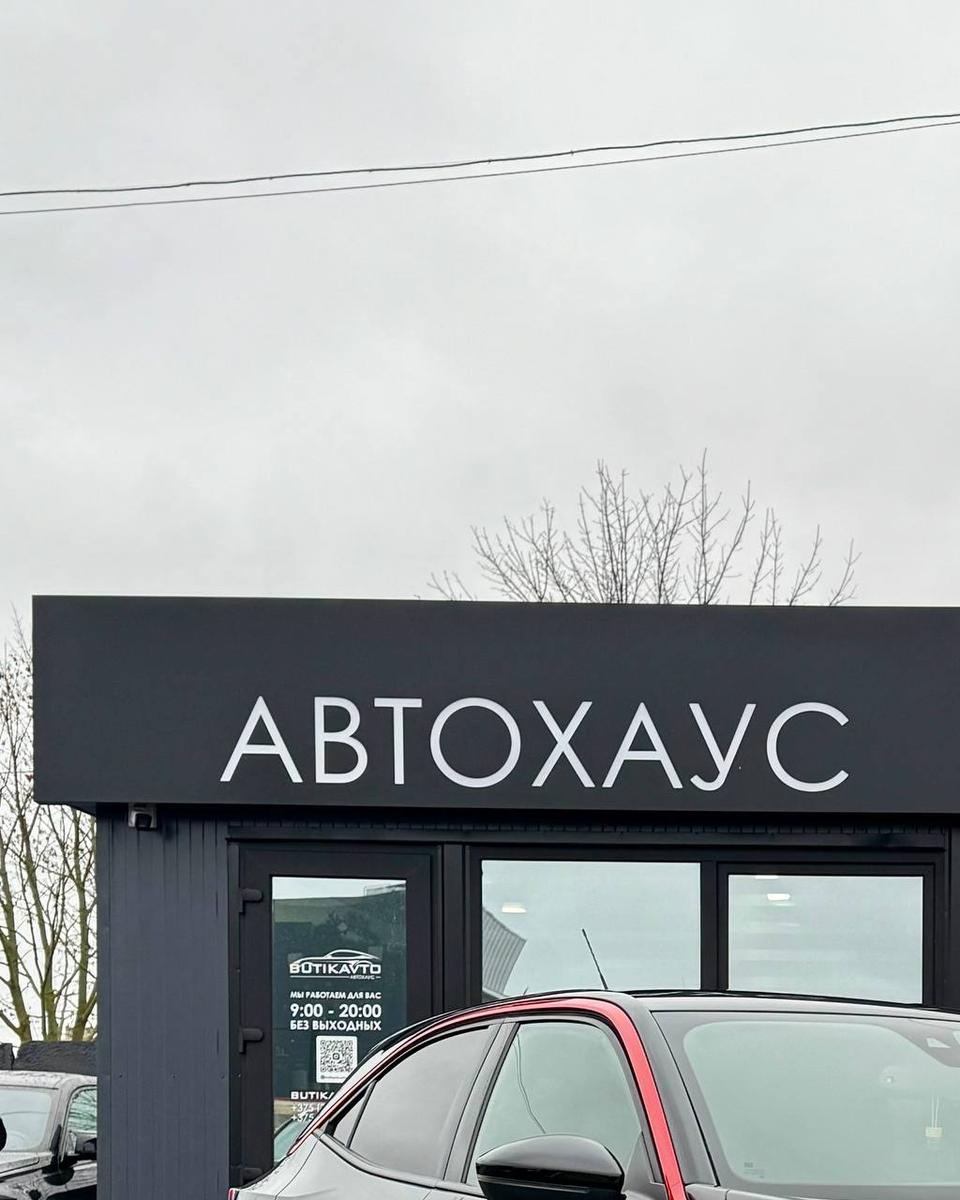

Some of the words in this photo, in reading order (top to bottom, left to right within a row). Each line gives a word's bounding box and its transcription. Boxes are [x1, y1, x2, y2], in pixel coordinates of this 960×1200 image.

[219, 695, 850, 793] АВТОХАУС
[289, 963, 382, 975] BUTIKAVTO
[290, 991, 304, 999] МЫ
[305, 991, 347, 1000] РАБОТАЕМ
[347, 991, 364, 1000] ДЛЯ
[290, 1003, 324, 1018] 9:00
[339, 1003, 382, 1018] 20:00
[290, 1020, 309, 1031] БЕЗ
[312, 1020, 381, 1032] ВЫХОДНЫХ
